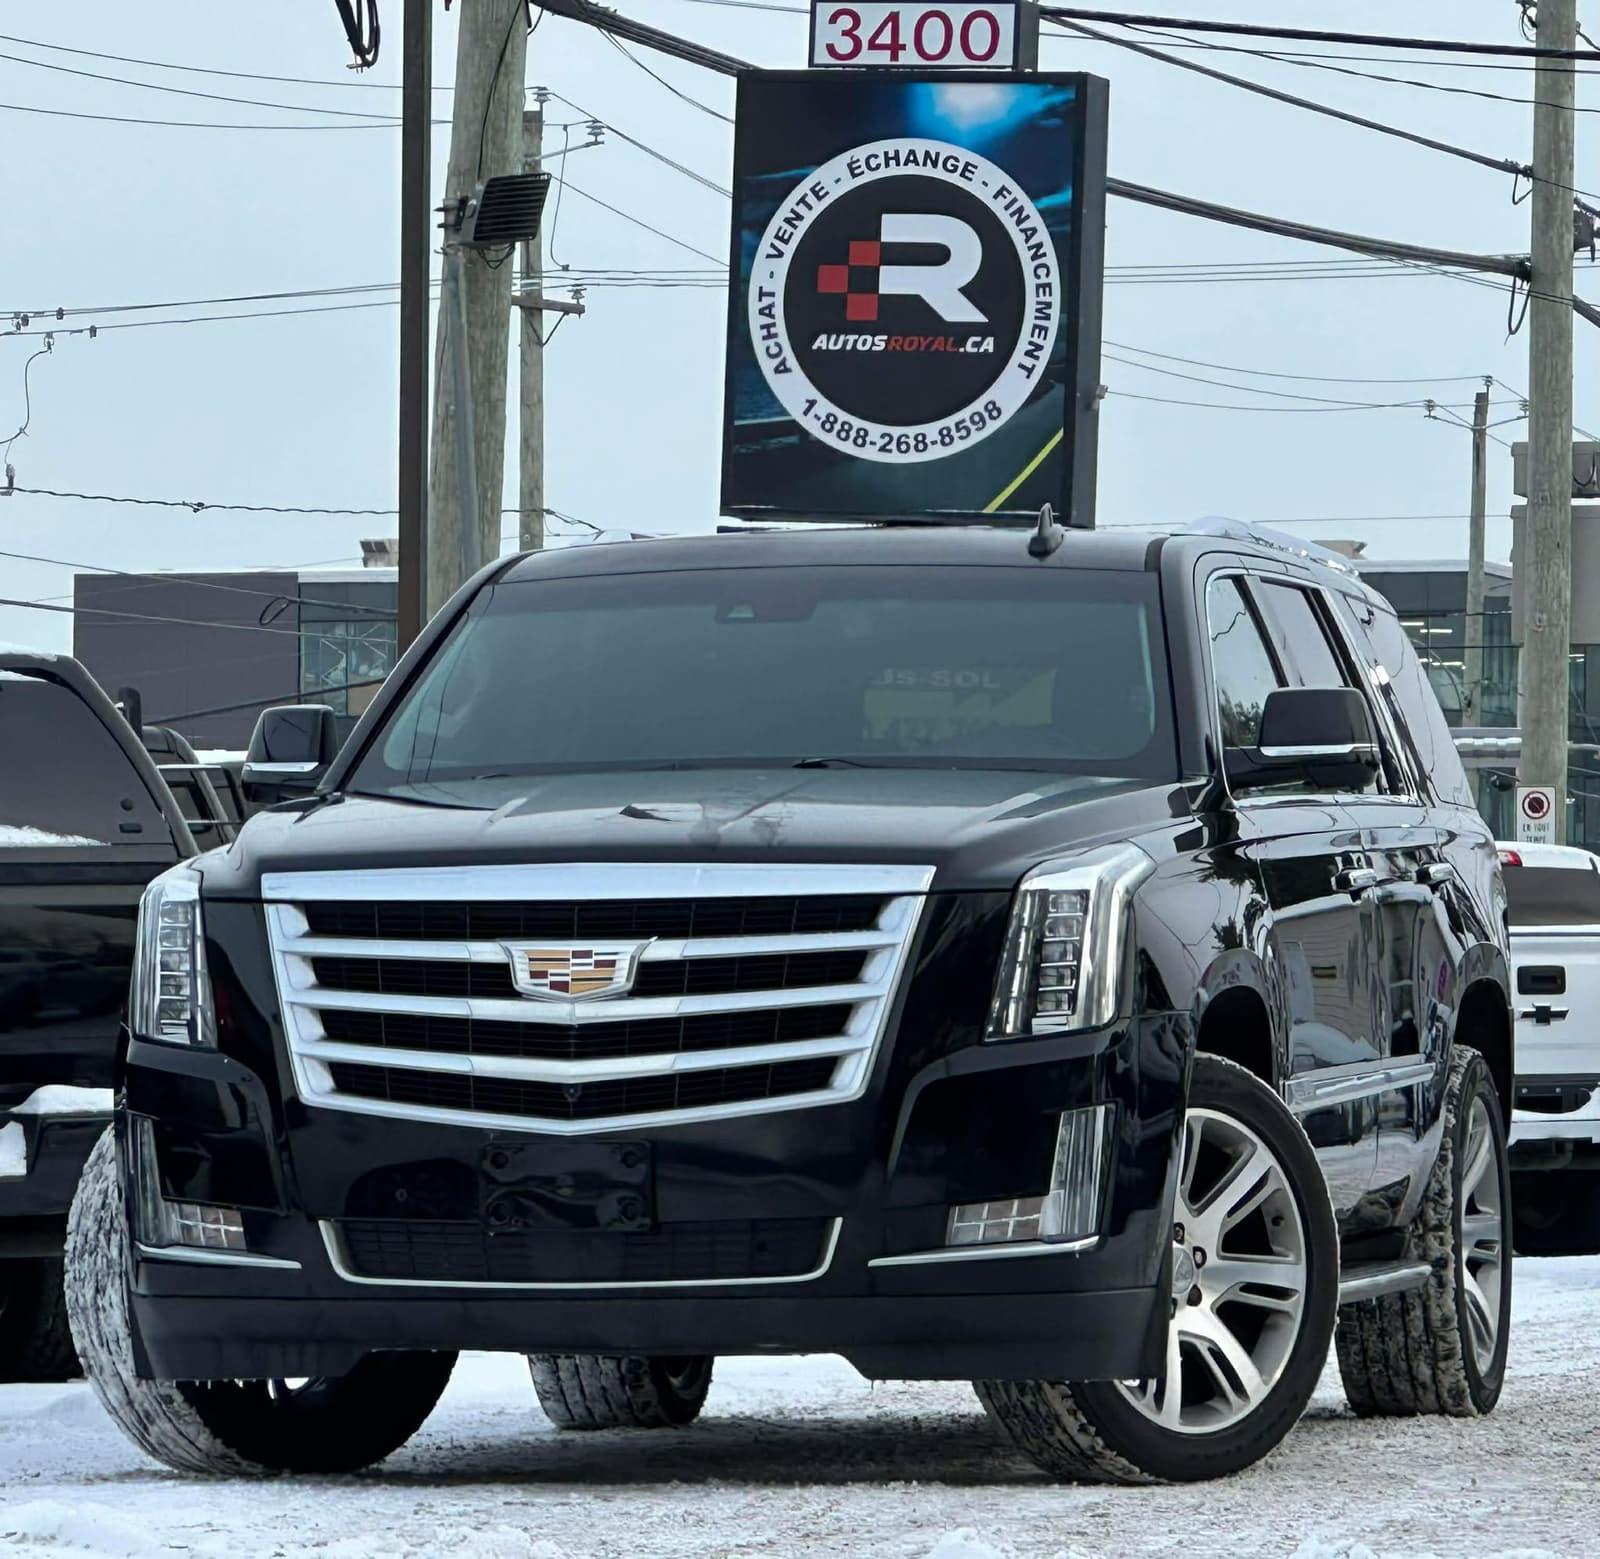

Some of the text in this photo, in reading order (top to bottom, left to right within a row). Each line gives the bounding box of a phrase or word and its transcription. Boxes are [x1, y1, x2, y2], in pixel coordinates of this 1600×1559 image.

[825, 8, 1000, 62] 3400
[847, 149, 978, 182] ÉCHANGE
[765, 181, 830, 262] VENTE
[879, 213, 990, 323] R
[992, 184, 1053, 379] FINANCEMENT
[758, 286, 792, 375] ACHAT
[811, 333, 995, 353] AUTOSROYAL.CA
[802, 398, 1003, 455] 1-888-268-8598
